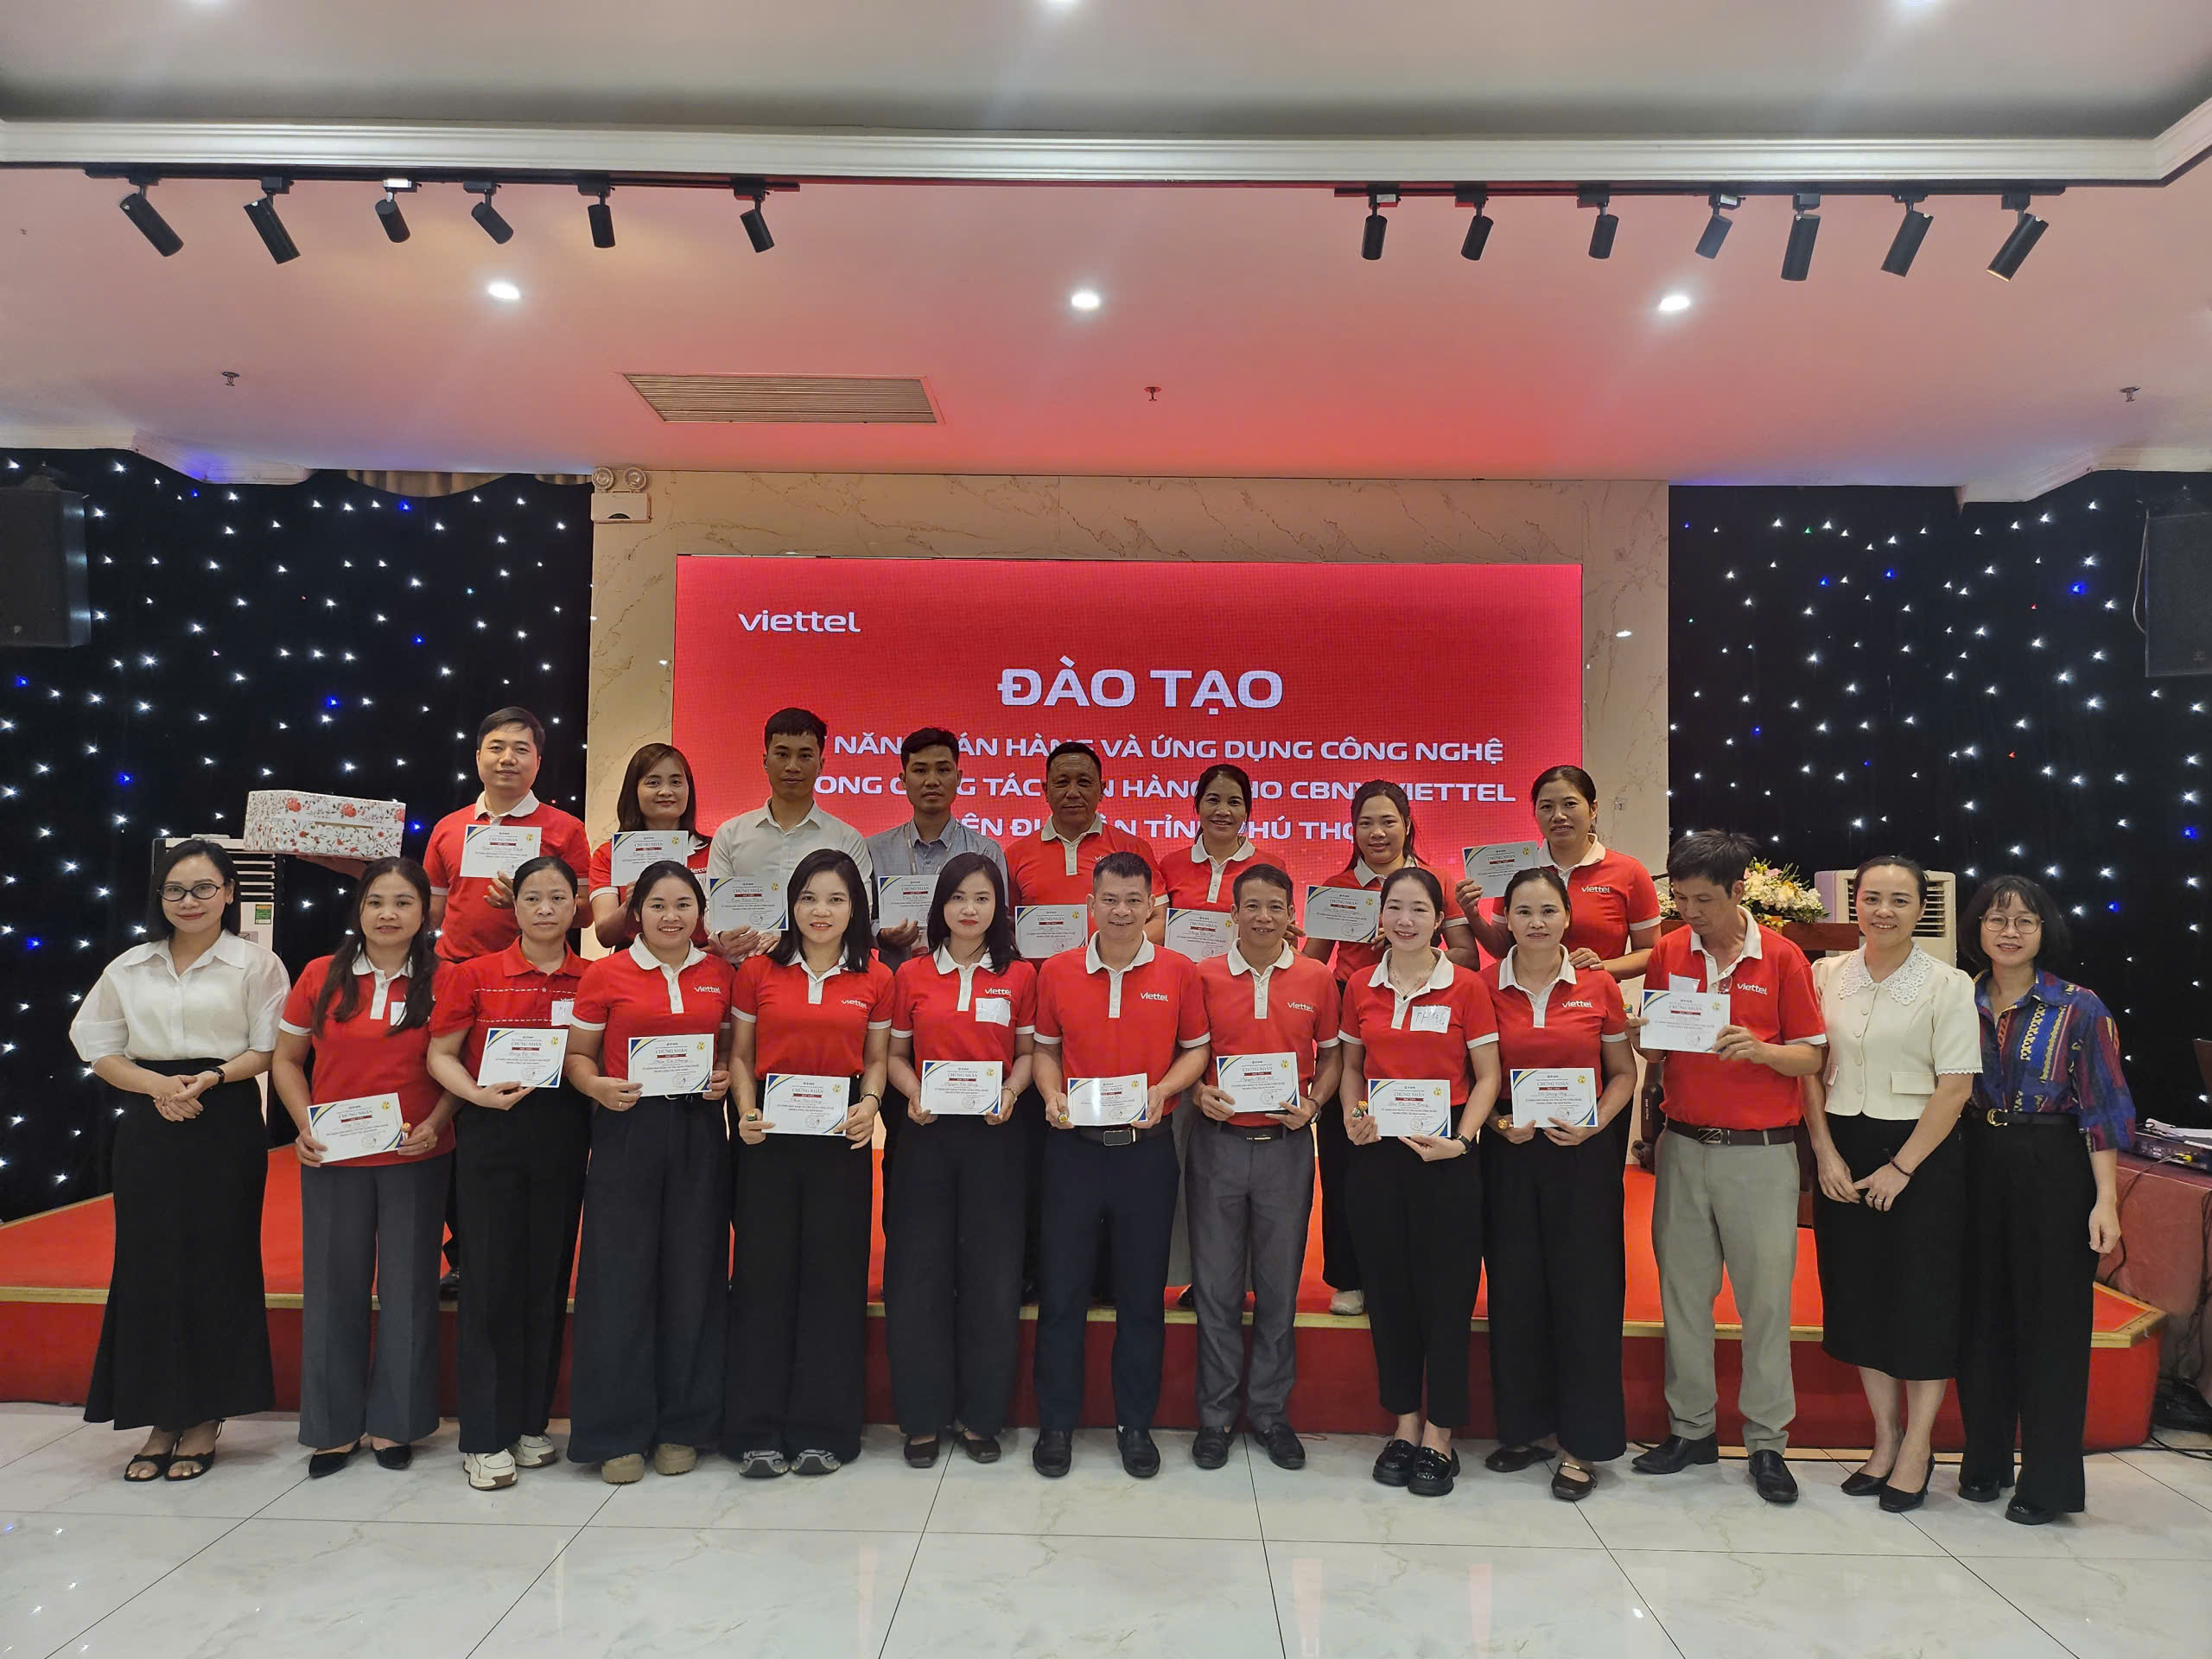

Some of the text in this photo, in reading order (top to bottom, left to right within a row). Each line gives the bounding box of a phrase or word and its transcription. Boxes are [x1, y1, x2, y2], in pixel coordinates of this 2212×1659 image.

[738, 610, 861, 632] viettel
[997, 655, 1283, 715] ĐÀO TẠO
[834, 732, 903, 754] NĂN
[958, 732, 998, 756] ÁN
[1100, 734, 1143, 758] VÀ
[1151, 734, 1217, 758] ỨNG
[1224, 741, 1313, 762] DỤNG
[1320, 736, 1408, 760] CÔNG
[1415, 737, 1503, 765] NGHỆ
[814, 775, 882, 794] ONG
[982, 772, 1041, 797] TÁC
[1251, 780, 1282, 799] HO
[1290, 781, 1362, 800] CBN
[1399, 783, 1516, 802] IETTEL
[1144, 814, 1201, 839] TỈN
[1238, 815, 1291, 839] HÚ
[694, 985, 721, 994] viettel
[1141, 992, 1168, 1001] viettel
[1737, 982, 1768, 995] viettel
[1287, 1001, 1314, 1013] viettel
